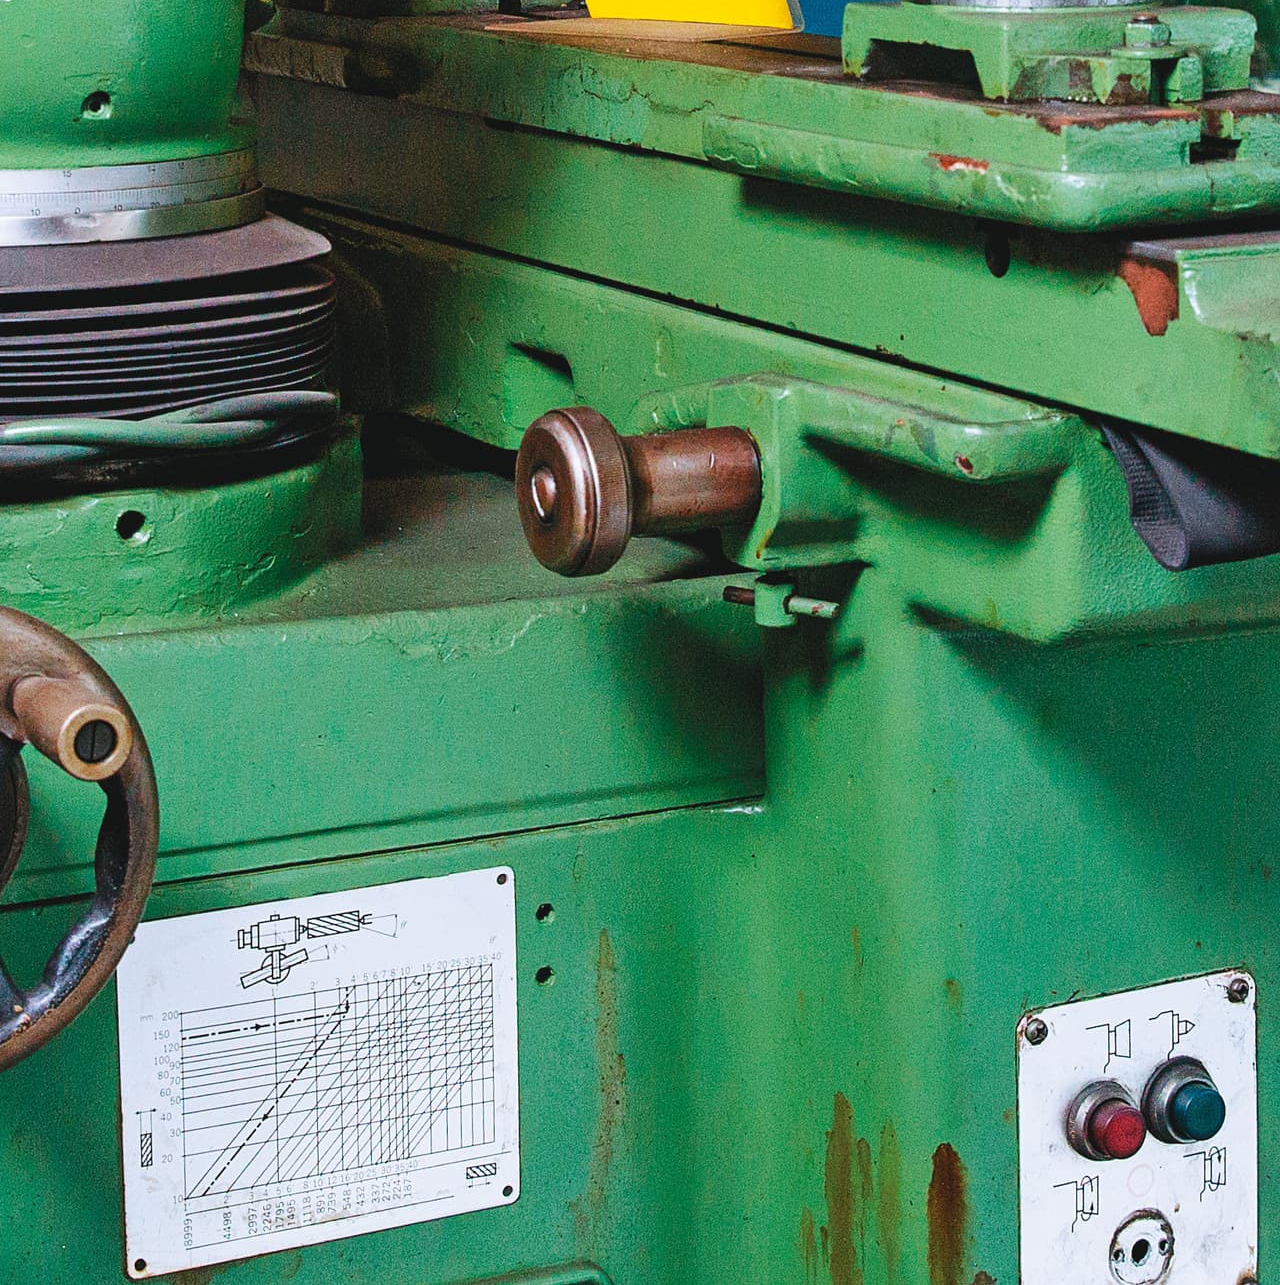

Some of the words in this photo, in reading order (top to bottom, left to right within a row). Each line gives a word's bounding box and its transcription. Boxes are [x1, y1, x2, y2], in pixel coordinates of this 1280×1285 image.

[161, 1011, 180, 1021] 200
[153, 1030, 170, 1041] 150
[163, 1043, 180, 1053] 120
[154, 1056, 171, 1066] 100
[159, 1088, 171, 1097] 60
[170, 1096, 181, 1106] 50
[170, 1128, 181, 1138] 30
[161, 1154, 173, 1163] 20
[372, 1184, 380, 1204] 337
[382, 1181, 391, 1202] 272
[404, 1178, 412, 1197] 187
[173, 1195, 183, 1204] 10
[303, 1196, 312, 1223] 1118
[317, 1194, 325, 1214] 891
[328, 1192, 337, 1213] 739
[343, 1189, 351, 1211] 548
[248, 1208, 257, 1234] 2997
[263, 1203, 272, 1232] 2246
[276, 1201, 285, 1228] 1795
[287, 1199, 296, 1226] 1495
[184, 1218, 192, 1247] 8999
